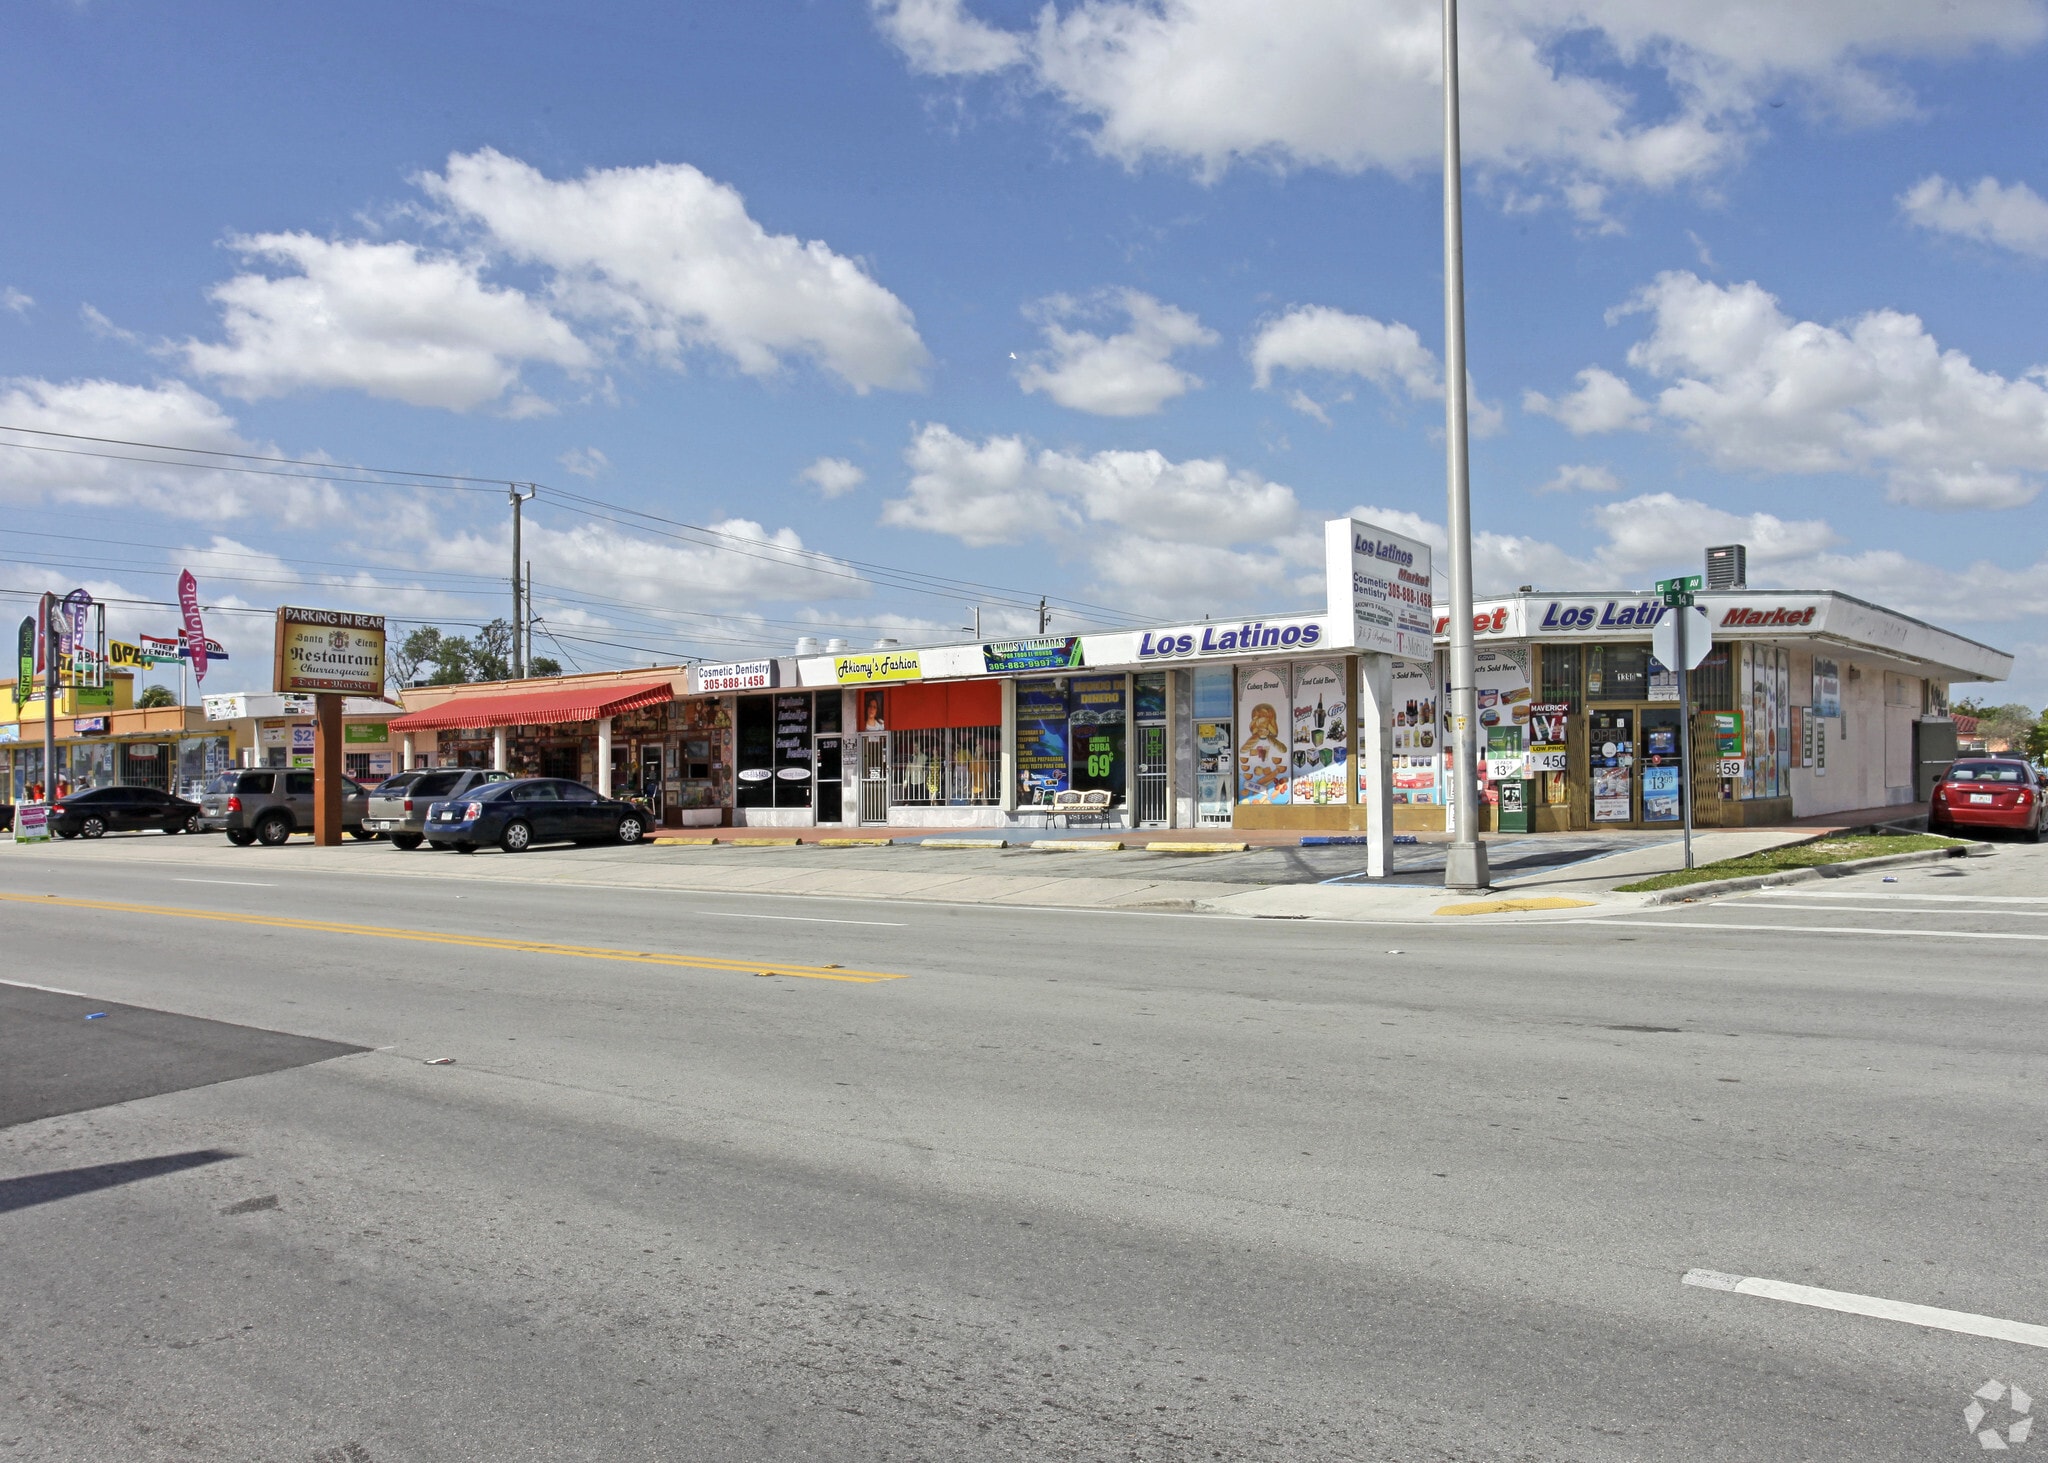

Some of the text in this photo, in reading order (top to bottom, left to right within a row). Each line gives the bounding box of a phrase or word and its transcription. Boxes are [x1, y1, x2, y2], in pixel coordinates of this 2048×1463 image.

[1355, 533, 1413, 566] Los Latinos
[1353, 572, 1388, 590] Cosmetic
[1398, 567, 1430, 588] Market
[1657, 579, 1699, 592] E 4 AV
[1353, 583, 1387, 601] Dentistry
[1388, 582, 1432, 608] 305-888-1458
[1665, 594, 1687, 606] E 14
[285, 608, 384, 628] PARKING IN REAR
[1435, 607, 1507, 634] ret
[1541, 602, 1597, 627] Los
[1721, 606, 1815, 626] Market
[295, 633, 378, 648] Santa Elena
[1140, 622, 1321, 656] Los Latinos
[151, 642, 176, 652] BIEN
[992, 641, 1019, 653] ENVIOS
[290, 646, 380, 667] Restaurant
[698, 661, 770, 678] Cosmetic Dentistry
[837, 655, 919, 679] Akiomy's Fashion
[989, 659, 1051, 671] 305-883-9997
[1487, 664, 1501, 673] Sold
[703, 674, 765, 690] 305-888-1458
[1301, 676, 1337, 686] Iced Cold Beer
[1397, 671, 1409, 680] Sold
[1246, 681, 1280, 691] Cuban Bread
[1531, 704, 1568, 712] MAVERICK
[1592, 729, 1627, 743] OPEN
[1088, 743, 1111, 752] CUBA
